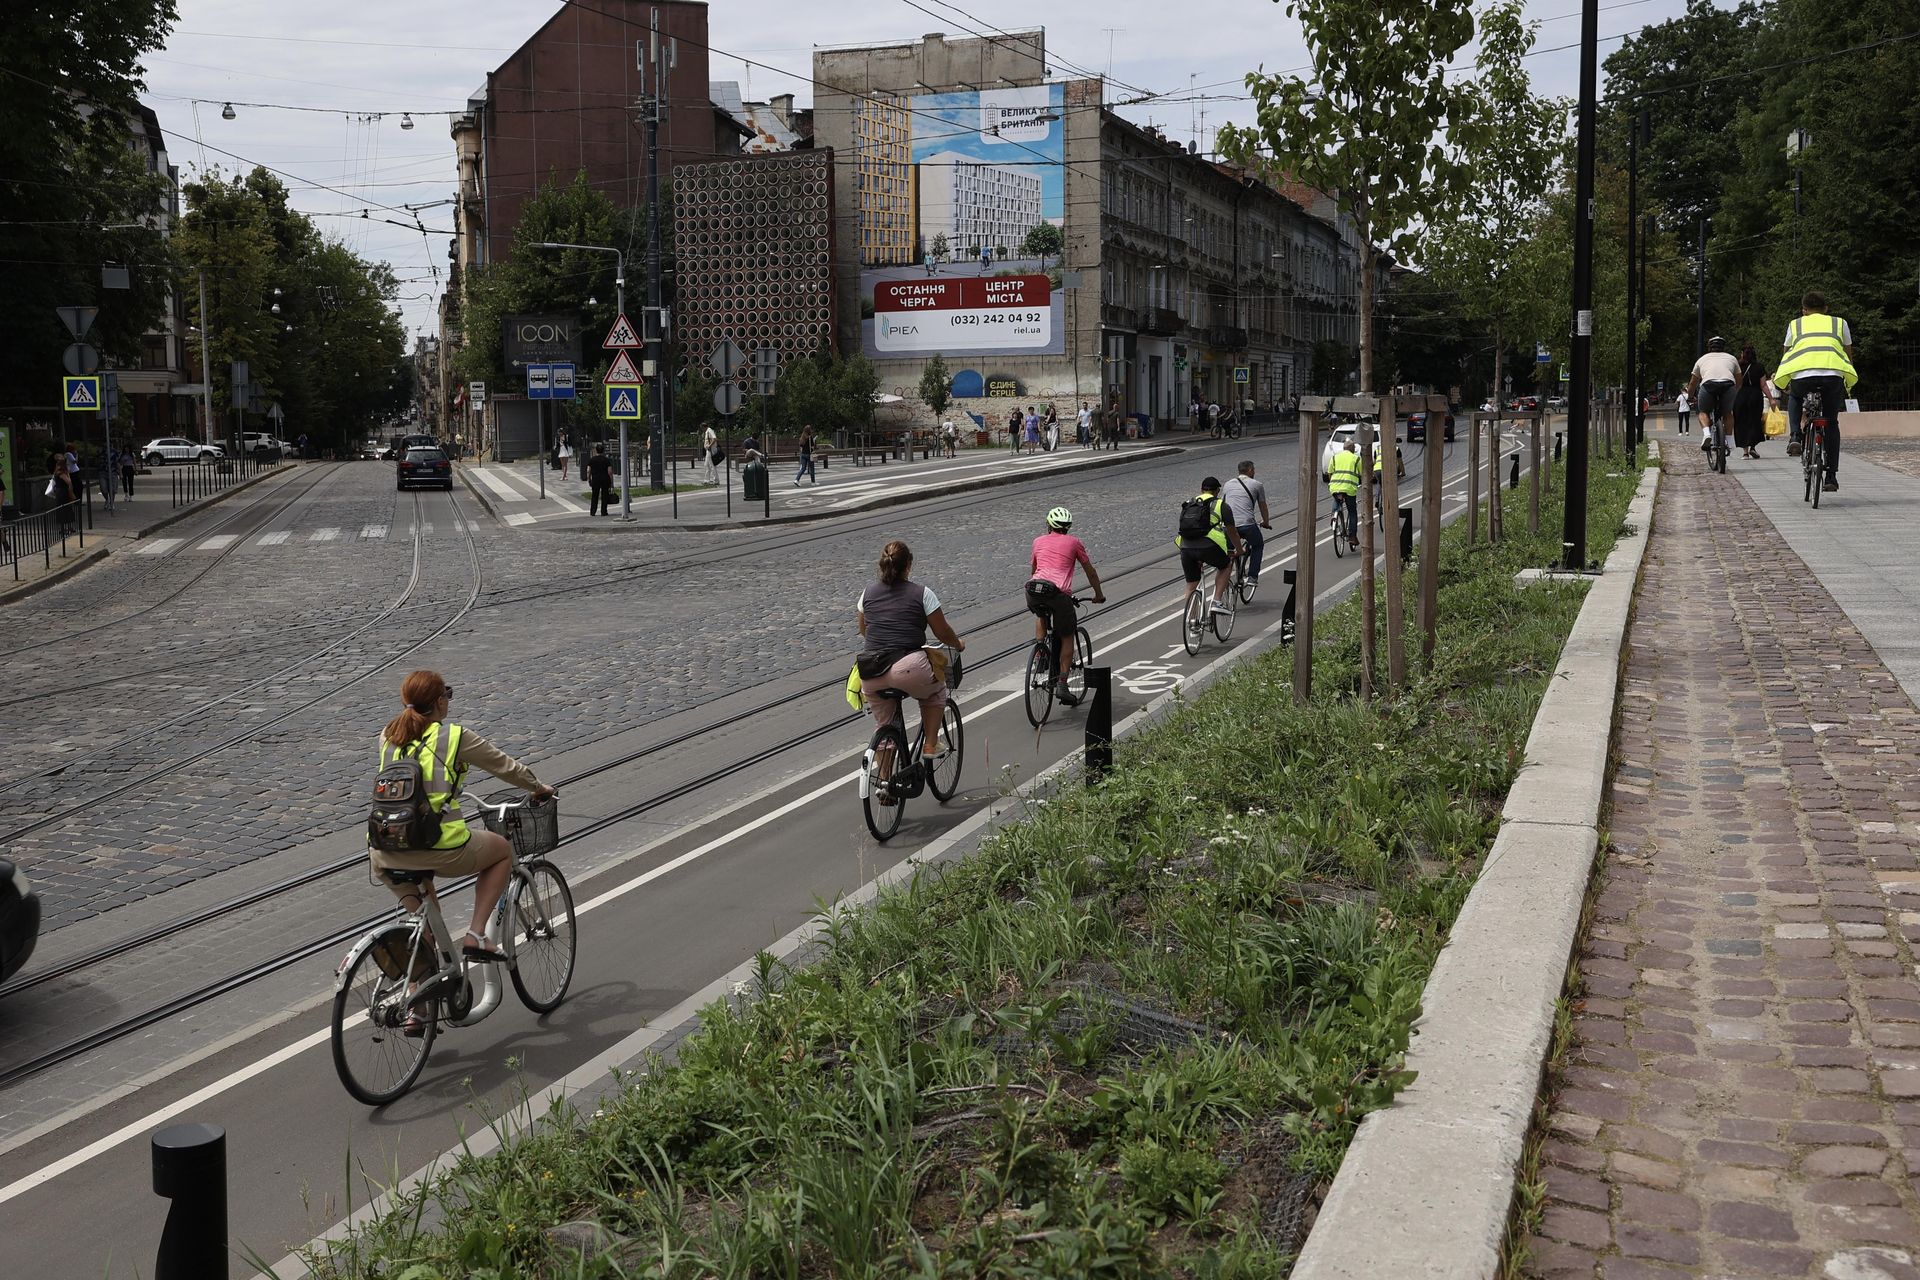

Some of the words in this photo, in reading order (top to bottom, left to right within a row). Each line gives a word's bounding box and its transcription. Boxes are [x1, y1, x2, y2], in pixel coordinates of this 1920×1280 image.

[1001, 107, 1037, 117] ВЕЛИКА
[1001, 119, 1045, 129] БРИТАНІЯ
[890, 284, 945, 296] ОСТАННЯ
[985, 281, 1025, 293] ЦЕНТР
[899, 297, 936, 308] ЧЕРГА
[986, 293, 1024, 304] МІСТА
[951, 314, 980, 326] (032)
[983, 314, 1004, 324] 242
[1008, 313, 1022, 323] 04
[1026, 312, 1041, 322] 92
[517, 324, 569, 342] ICON
[1013, 326, 1041, 335] riel.ua
[989, 381, 1016, 390] ЄДИНЕ
[989, 389, 1016, 398] СЕРЦЕ
